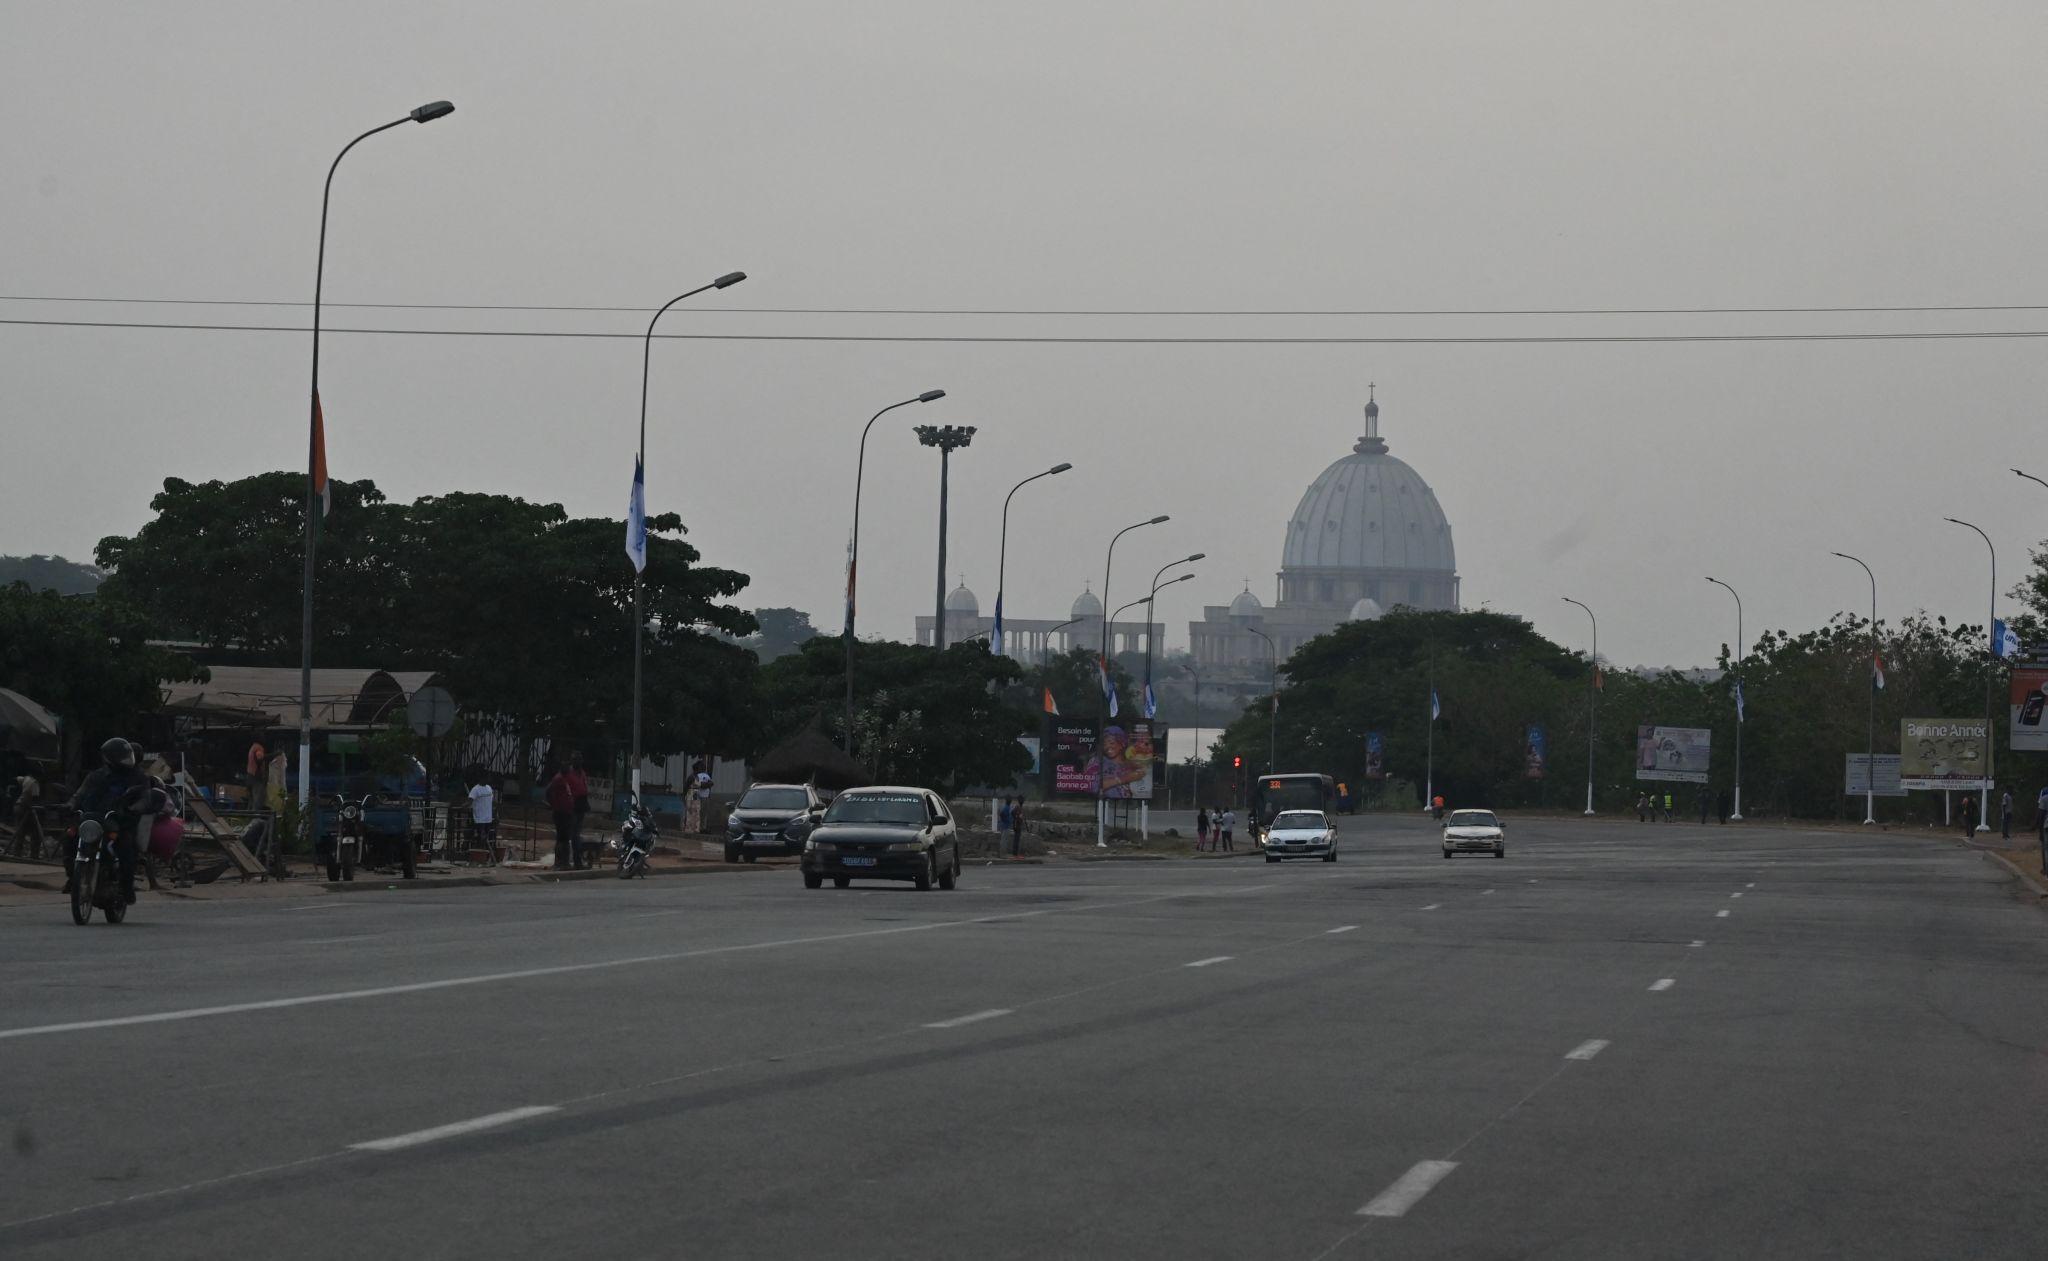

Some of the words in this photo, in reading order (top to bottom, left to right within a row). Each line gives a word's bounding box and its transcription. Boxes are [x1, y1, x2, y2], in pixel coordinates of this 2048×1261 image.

[1057, 726, 1082, 735] Besoin
[1083, 727, 1092, 735] de
[1907, 723, 1948, 737] Bonne
[1084, 773, 1096, 781] qui
